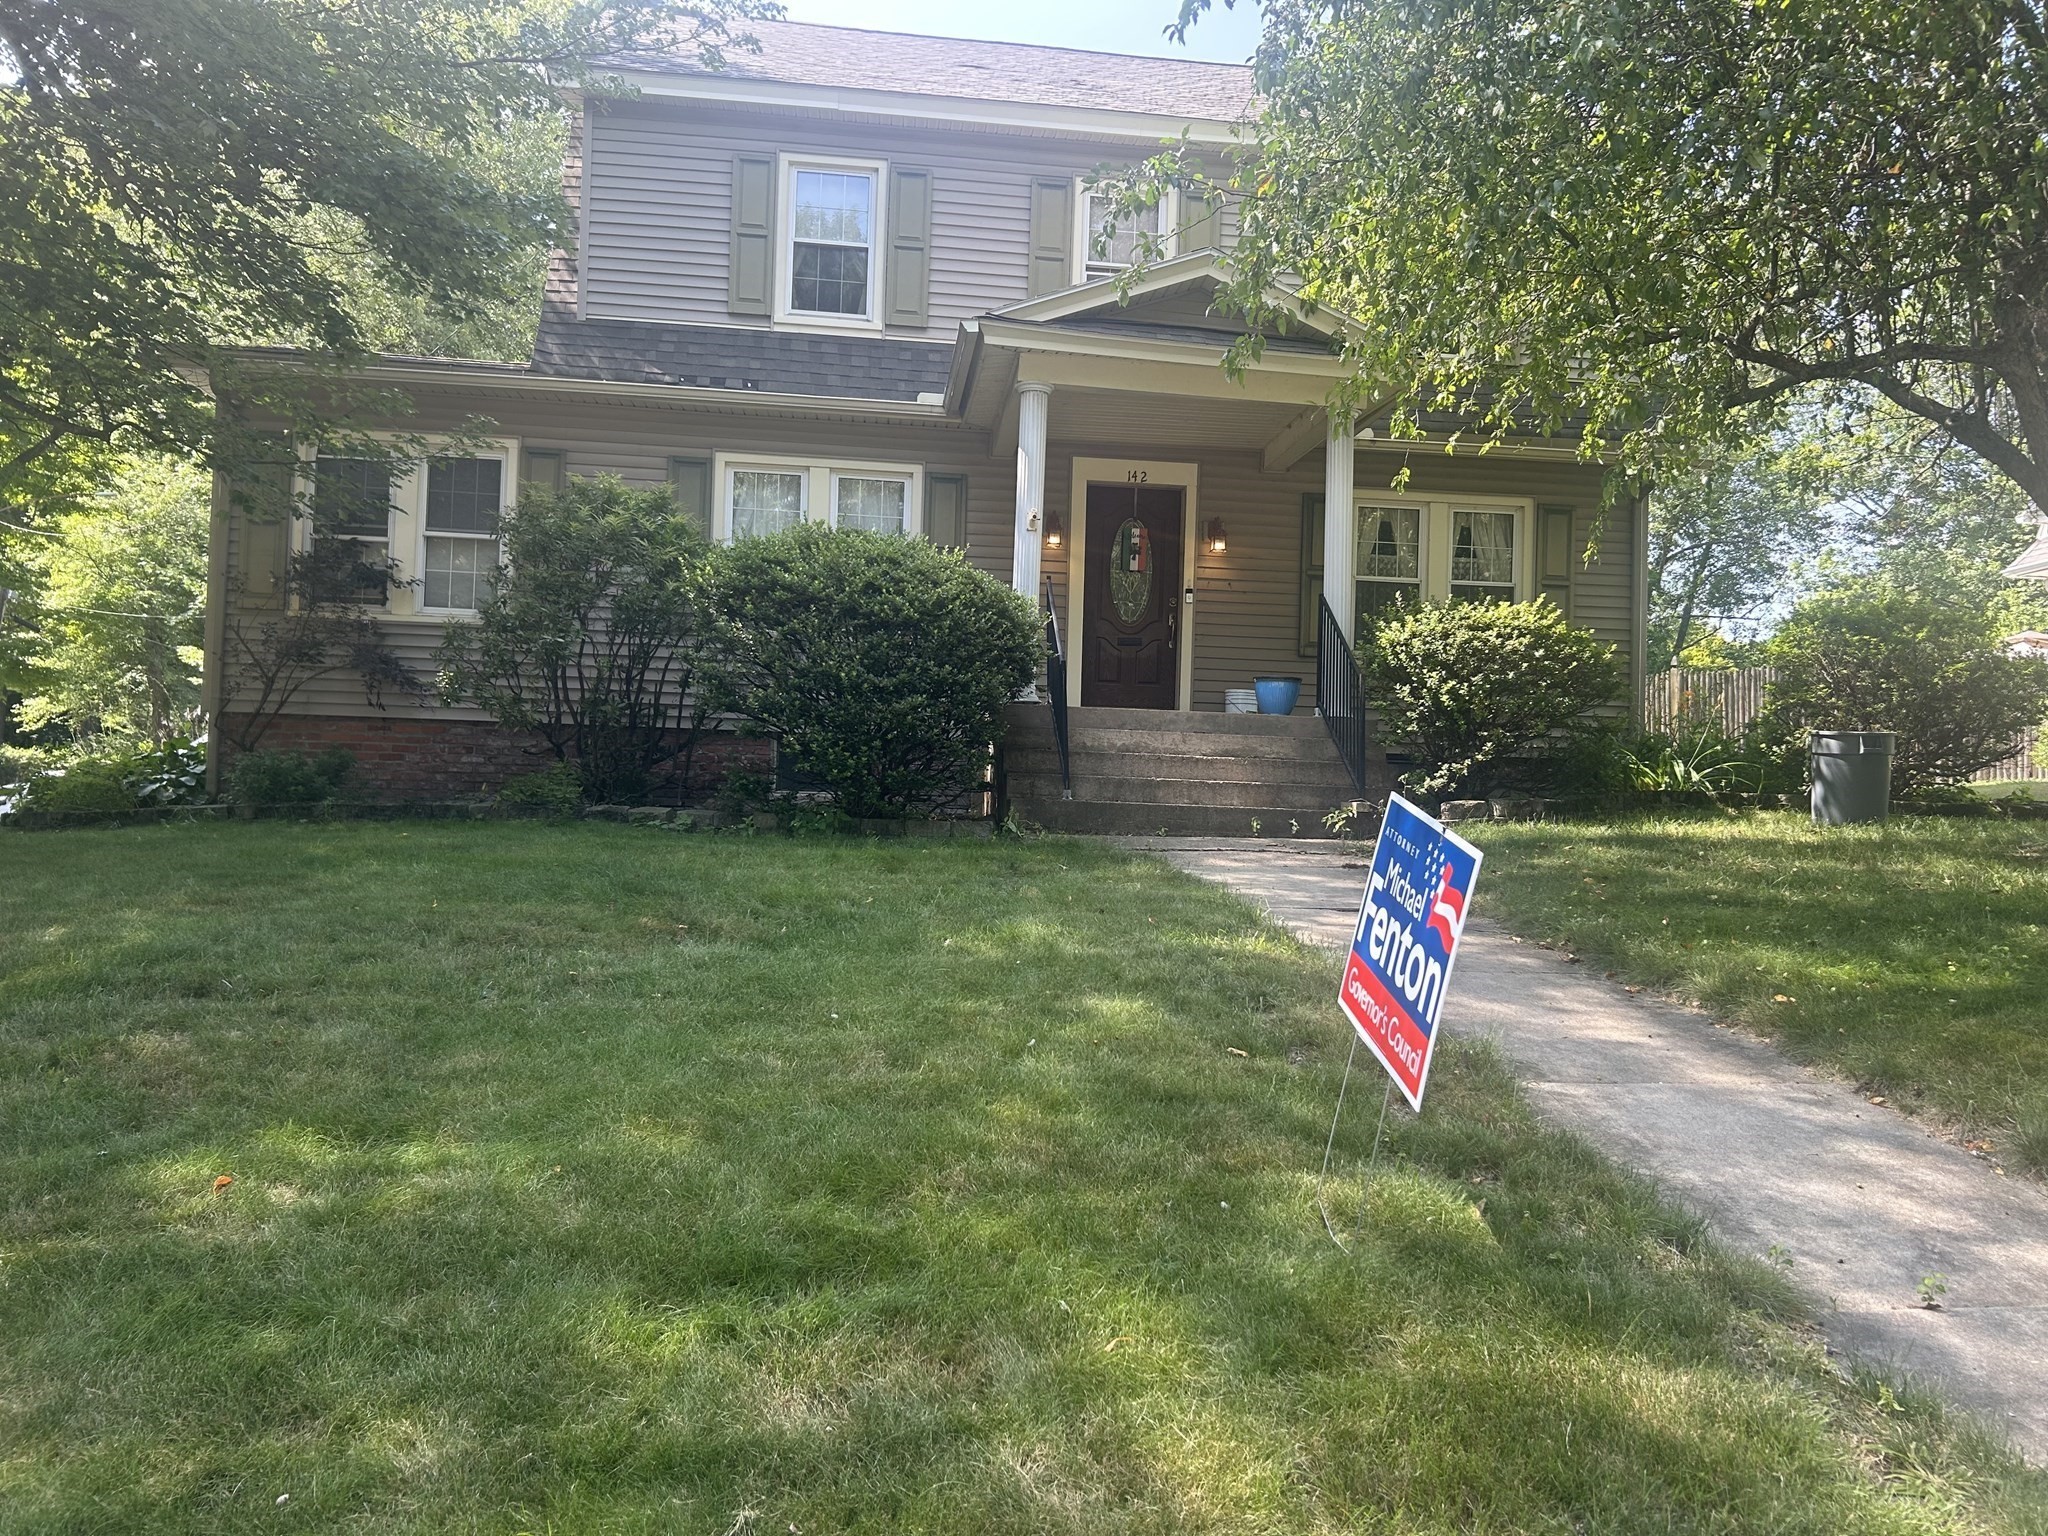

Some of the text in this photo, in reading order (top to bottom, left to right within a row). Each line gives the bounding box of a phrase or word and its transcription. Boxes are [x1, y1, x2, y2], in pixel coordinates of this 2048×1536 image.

[1127, 470, 1148, 483] 142
[1384, 826, 1420, 859] ATTORNEY
[1384, 857, 1428, 921] Michael
[1357, 871, 1441, 1024] Fenton
[1348, 967, 1422, 1078] Governor's Council
